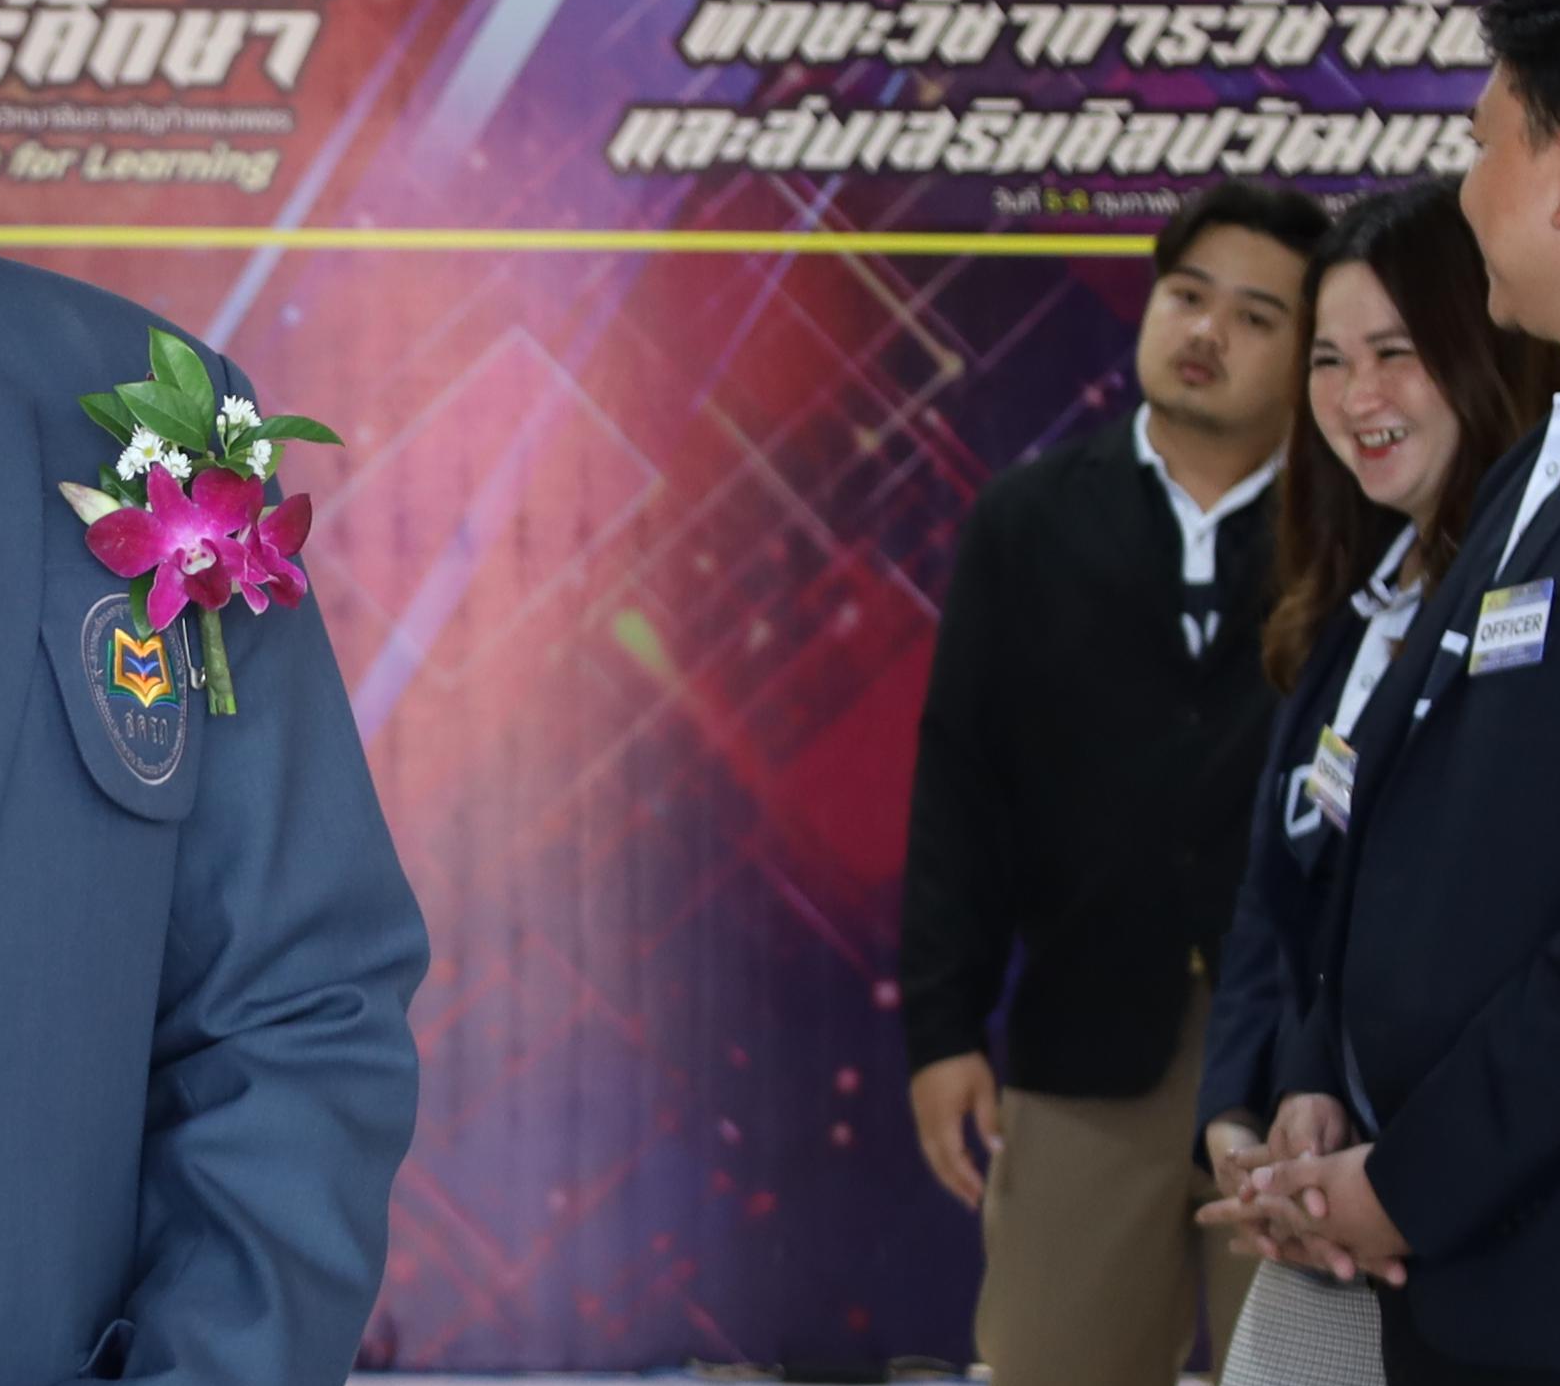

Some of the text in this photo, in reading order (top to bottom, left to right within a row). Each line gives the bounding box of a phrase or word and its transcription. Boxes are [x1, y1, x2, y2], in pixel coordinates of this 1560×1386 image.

[607, 95, 1479, 174] และส่งเสริมศิลปวัฒนธ
[9, 140, 80, 181] for
[82, 140, 280, 192] Learning
[1480, 612, 1543, 643] OFFICER
